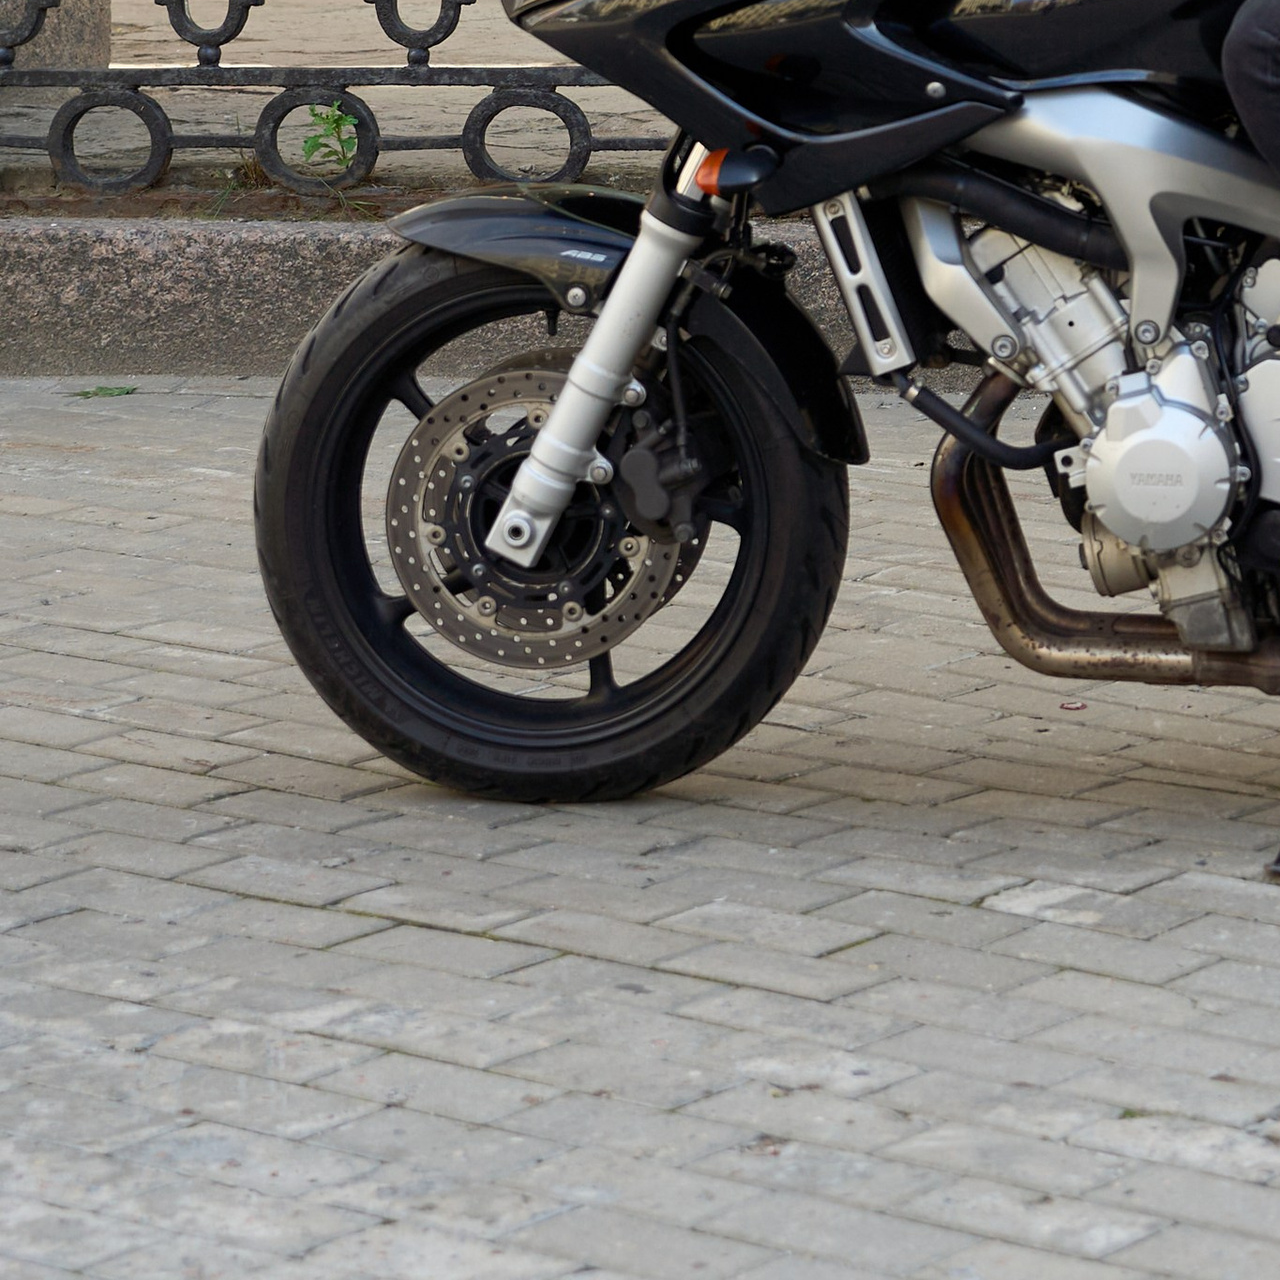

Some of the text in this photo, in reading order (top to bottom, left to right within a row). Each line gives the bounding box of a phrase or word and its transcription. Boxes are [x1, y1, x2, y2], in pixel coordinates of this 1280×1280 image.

[559, 249, 608, 263] ABS
[1130, 472, 1184, 487] YAMAHA
[306, 598, 384, 700] MICHELIN
